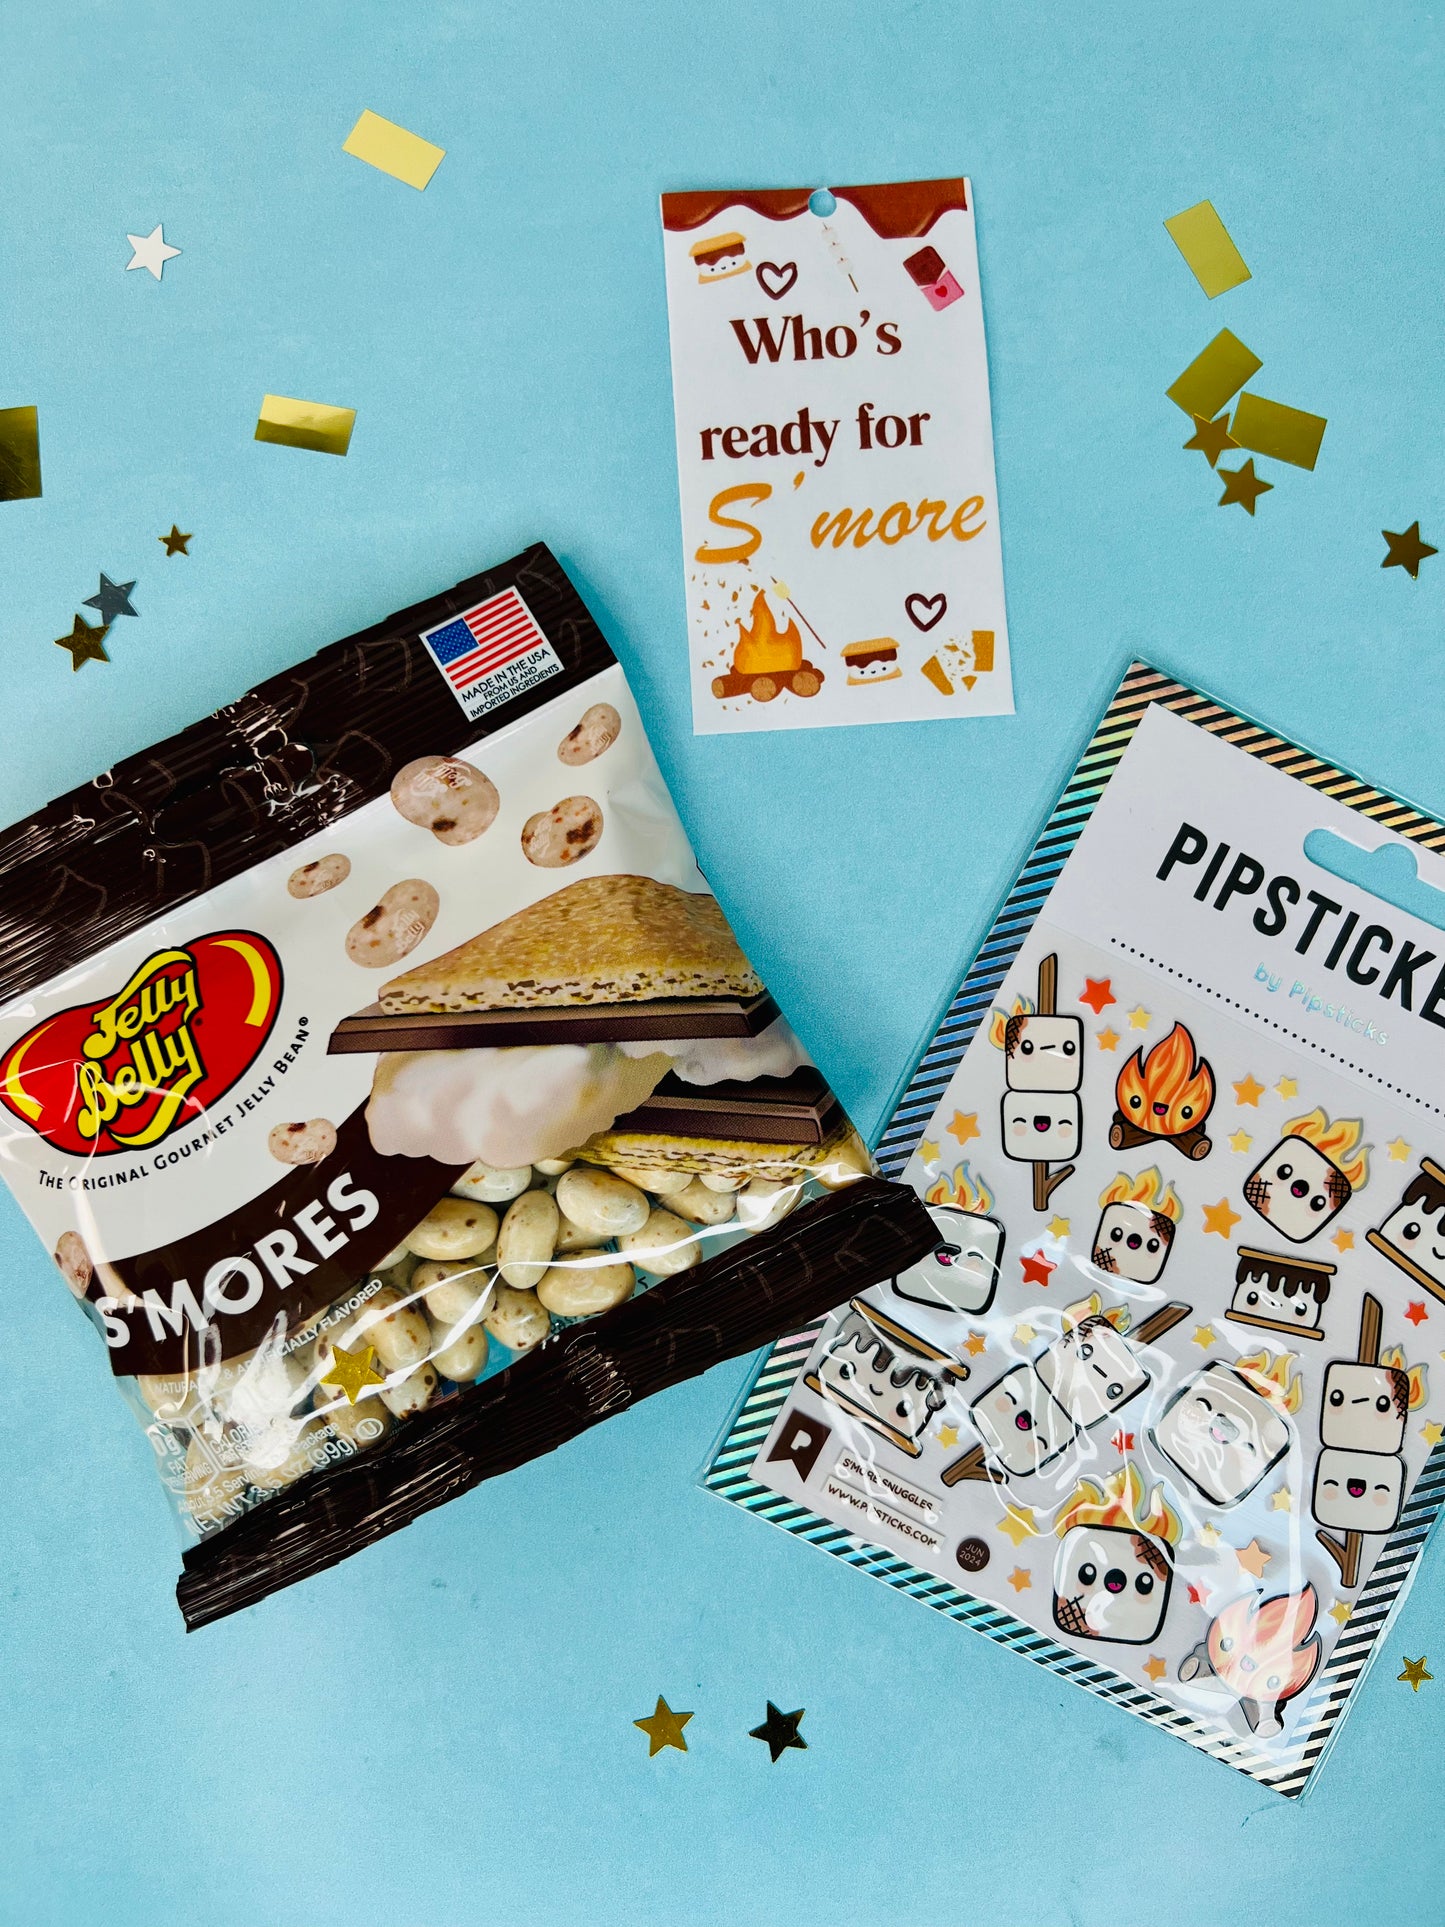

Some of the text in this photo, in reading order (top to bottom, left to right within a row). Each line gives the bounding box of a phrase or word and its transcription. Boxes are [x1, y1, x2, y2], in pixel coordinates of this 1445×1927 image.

[699, 403, 931, 468] ready for
[461, 648, 551, 703] MADE IN THE USA
[470, 663, 560, 718] IMPORTED INGREDIENTS
[483, 666, 538, 701] FROM US AND
[82, 947, 202, 1060] Jelly
[1253, 962, 1390, 1047] by Pipsticks
[77, 1025, 203, 1146] Belly
[39, 1169, 64, 1190] THE
[235, 1075, 276, 1118] JELLY
[237, 1326, 320, 1374] ARIFICIALLY
[319, 1278, 383, 1331] FLAVORED
[168, 1456, 188, 1475] FAT
[184, 1509, 221, 1536] NET
[219, 1492, 253, 1516] WT
[959, 1551, 982, 1567] 2024
[964, 1543, 985, 1557] JUN
